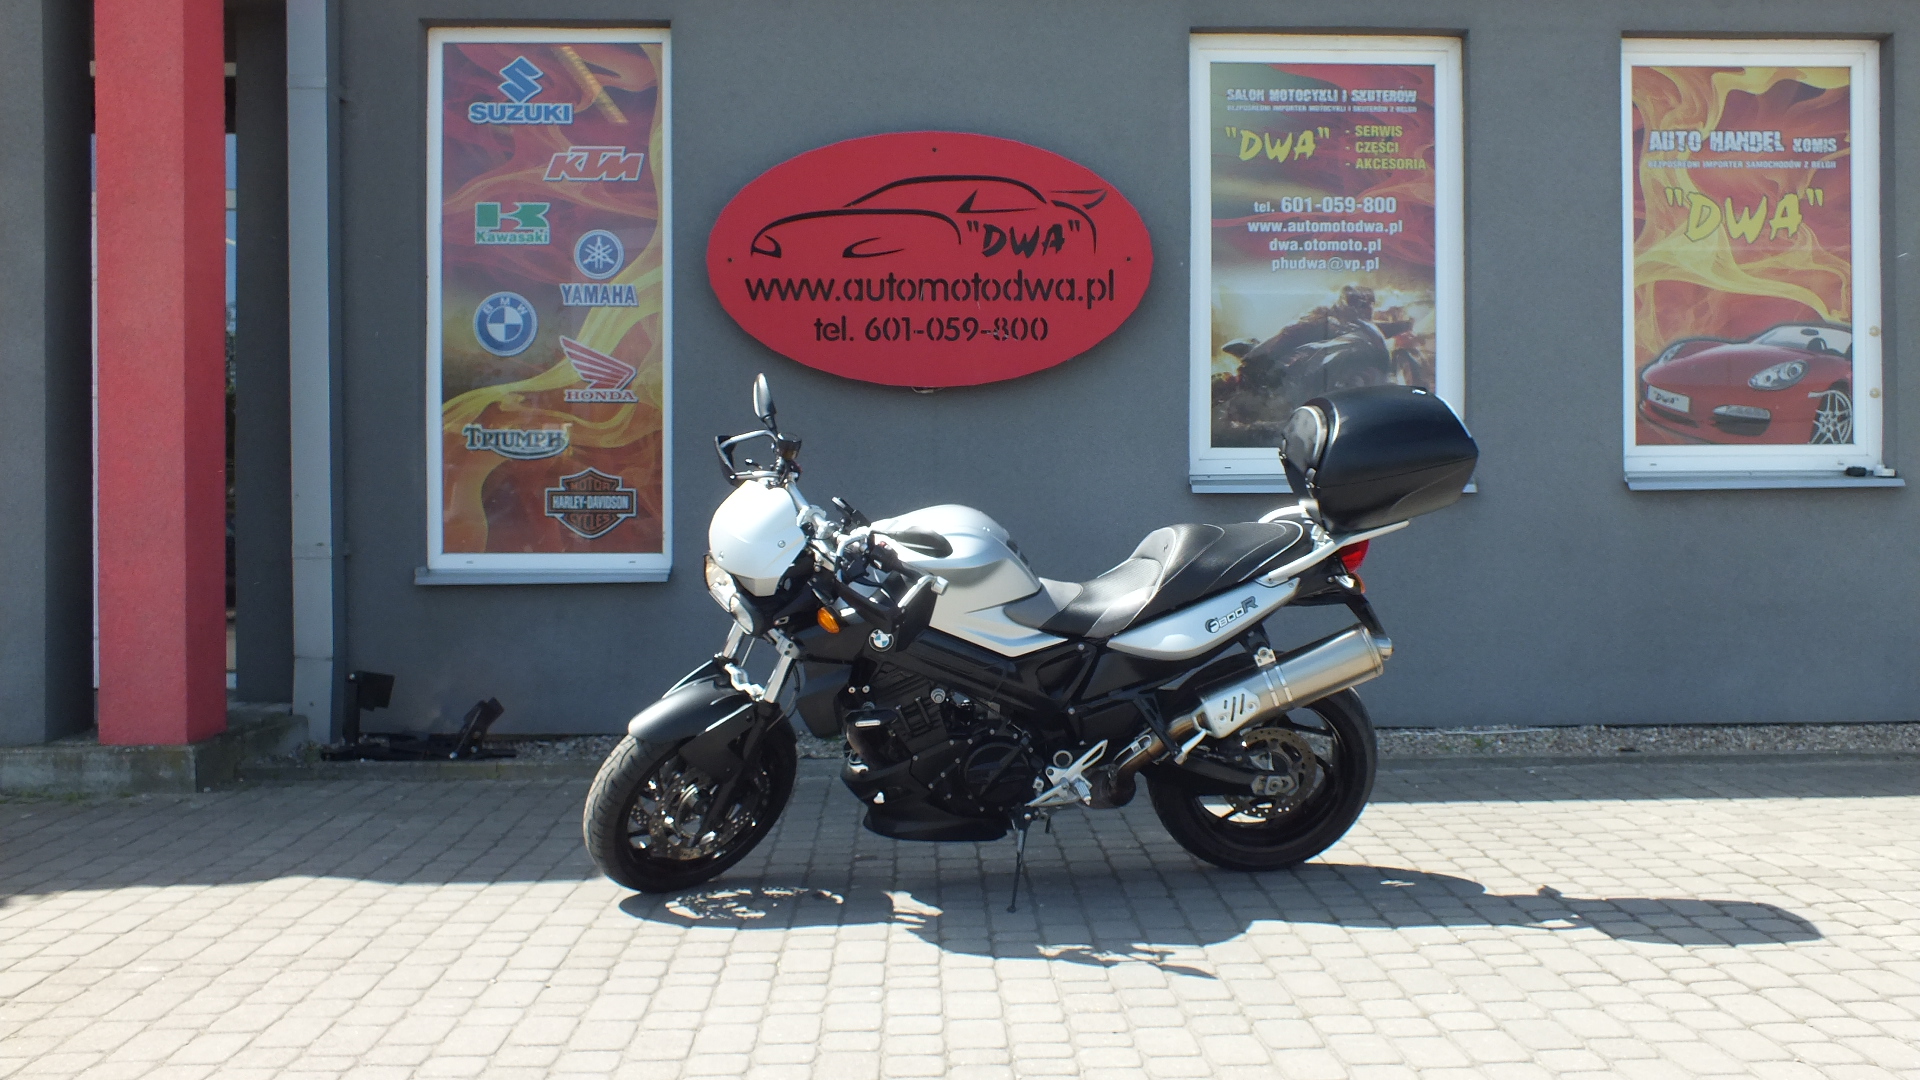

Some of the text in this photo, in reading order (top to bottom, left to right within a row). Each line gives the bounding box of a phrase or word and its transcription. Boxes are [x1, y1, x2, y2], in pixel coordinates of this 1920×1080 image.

[1226, 88, 1265, 102] SALON
[1269, 89, 1338, 102] MOTOCYKLI
[468, 103, 573, 124] SUZUKI
[1355, 125, 1403, 137] SERWIS
[1226, 126, 1330, 163] "DWA"
[1355, 139, 1399, 155] CZĘŚCI
[1649, 130, 1838, 153] AUTO HANDEL KOMIS
[543, 146, 645, 181] KTM
[1355, 158, 1426, 170] AKCESORIA
[1254, 196, 1397, 213] tel. 601-059-800
[1665, 187, 1824, 244] "DWA"
[1248, 220, 1403, 234] www.automotodwa.pl
[475, 230, 549, 244] Kawasaki
[967, 220, 1081, 258] "DWA"
[1269, 238, 1382, 253] dwa.otomoto.pl
[1272, 257, 1379, 272] phudwa@vp.pl
[560, 283, 639, 306] YAMAHA
[745, 269, 1115, 309] www.automotodwa.pl
[483, 297, 528, 315] BMW
[814, 316, 1049, 341] tel. 601-059-800
[565, 389, 638, 402] HONDA
[552, 495, 629, 510] HARLEY-DAVIDSON
